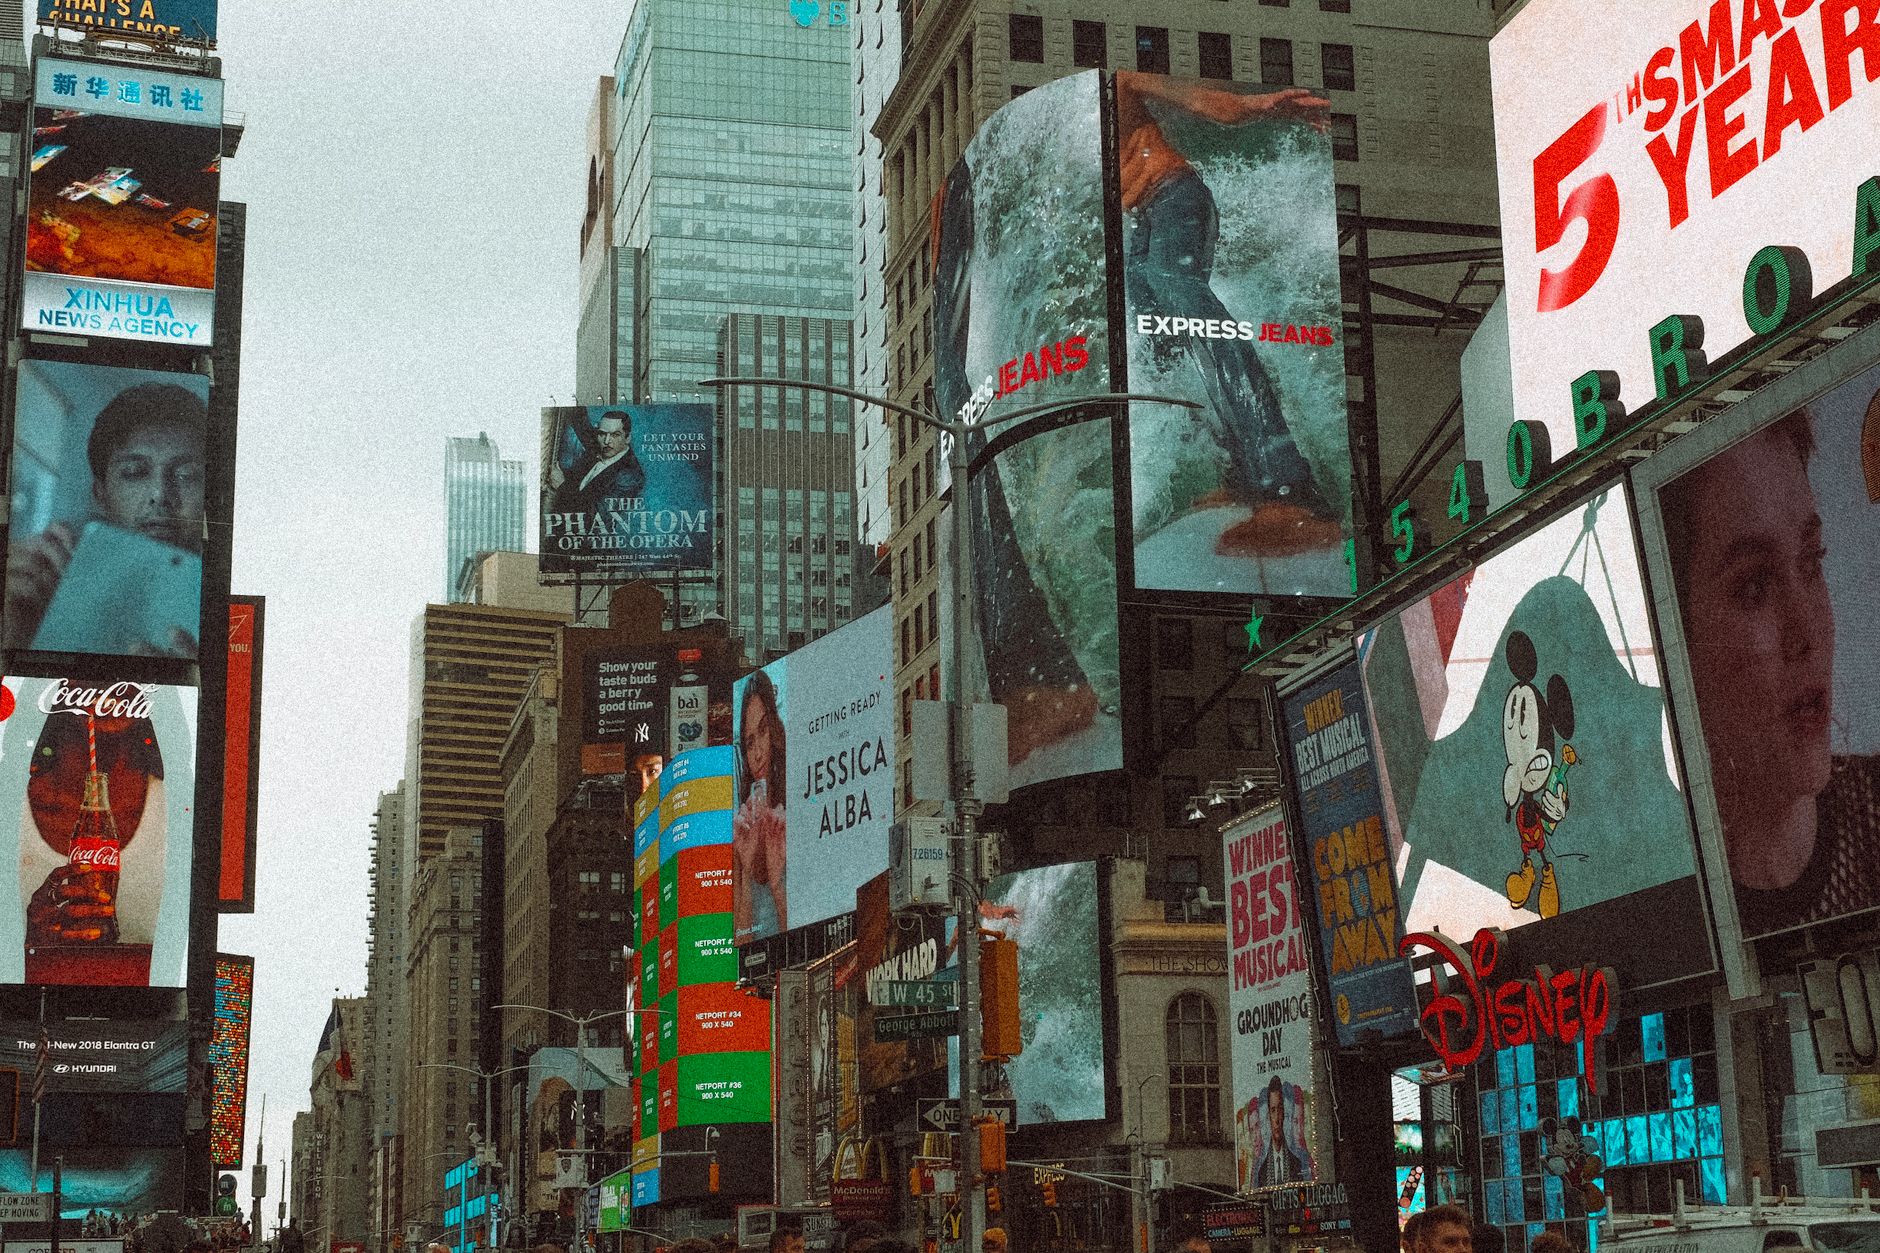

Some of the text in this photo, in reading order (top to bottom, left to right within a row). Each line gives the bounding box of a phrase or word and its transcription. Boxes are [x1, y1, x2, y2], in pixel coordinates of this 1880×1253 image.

[139, 0, 155, 20] A
[1643, 0, 1815, 133] SMA
[53, 72, 204, 112] 新华通讯社
[64, 287, 175, 319] XINHUA
[39, 309, 199, 339] NEWS AGENCY
[1137, 314, 1334, 347] EXPRESS JEANS
[995, 336, 1089, 400] JEANS
[641, 443, 707, 452] FANTASIES
[643, 433, 705, 442] LET YOUR
[650, 453, 699, 462] UNWIND
[605, 497, 646, 511] THE
[543, 509, 709, 537] PHANTOM
[558, 534, 694, 550] OF THE OPERA
[599, 661, 657, 673] Show your
[599, 673, 657, 687] taste buds
[38, 677, 159, 719] Coca-Cola
[599, 688, 642, 700] a berry
[599, 700, 654, 715] good time
[808, 690, 881, 735] GETTING READY
[1295, 711, 1366, 775] BEST MUSICAL
[803, 735, 888, 799] JESSICA
[819, 789, 872, 839] ALBA
[69, 846, 120, 867] Coca-Cola
[913, 848, 943, 860] 726159
[1314, 815, 1387, 881] COME
[695, 869, 727, 879] NETPORT
[701, 878, 733, 888] 900 X 540
[1319, 860, 1394, 930] FROM
[1231, 861, 1301, 950] BEST
[695, 938, 727, 948] NETPORT
[701, 947, 733, 957] 900 X 540
[1331, 908, 1397, 976] AWAY
[902, 937, 937, 981] HARD
[1151, 956, 1181, 971] THE
[1233, 931, 1308, 992] MUSICAL
[893, 983, 908, 1003] W
[915, 983, 935, 1004] 45
[695, 1010, 742, 1020] NETPORT #34
[878, 1013, 955, 1034] George Abbott
[1237, 992, 1309, 1036] GROUNDHOG
[701, 1021, 713, 1029] 900
[721, 1020, 734, 1028] 540
[17, 1041, 37, 1050] The
[79, 1041, 102, 1050] 2018
[104, 1040, 140, 1050] Elantra
[141, 1041, 156, 1050] GT
[1262, 1027, 1283, 1057] DAY
[72, 1064, 117, 1073] HYUNDAI
[695, 1081, 742, 1090] NETPORT #36
[933, 1109, 961, 1123] ONE
[20, 1196, 40, 1206] ZONE
[1272, 1188, 1299, 1211] GIFTS
[11, 1208, 39, 1218] MOVING
[1320, 1220, 1337, 1231] SONY
